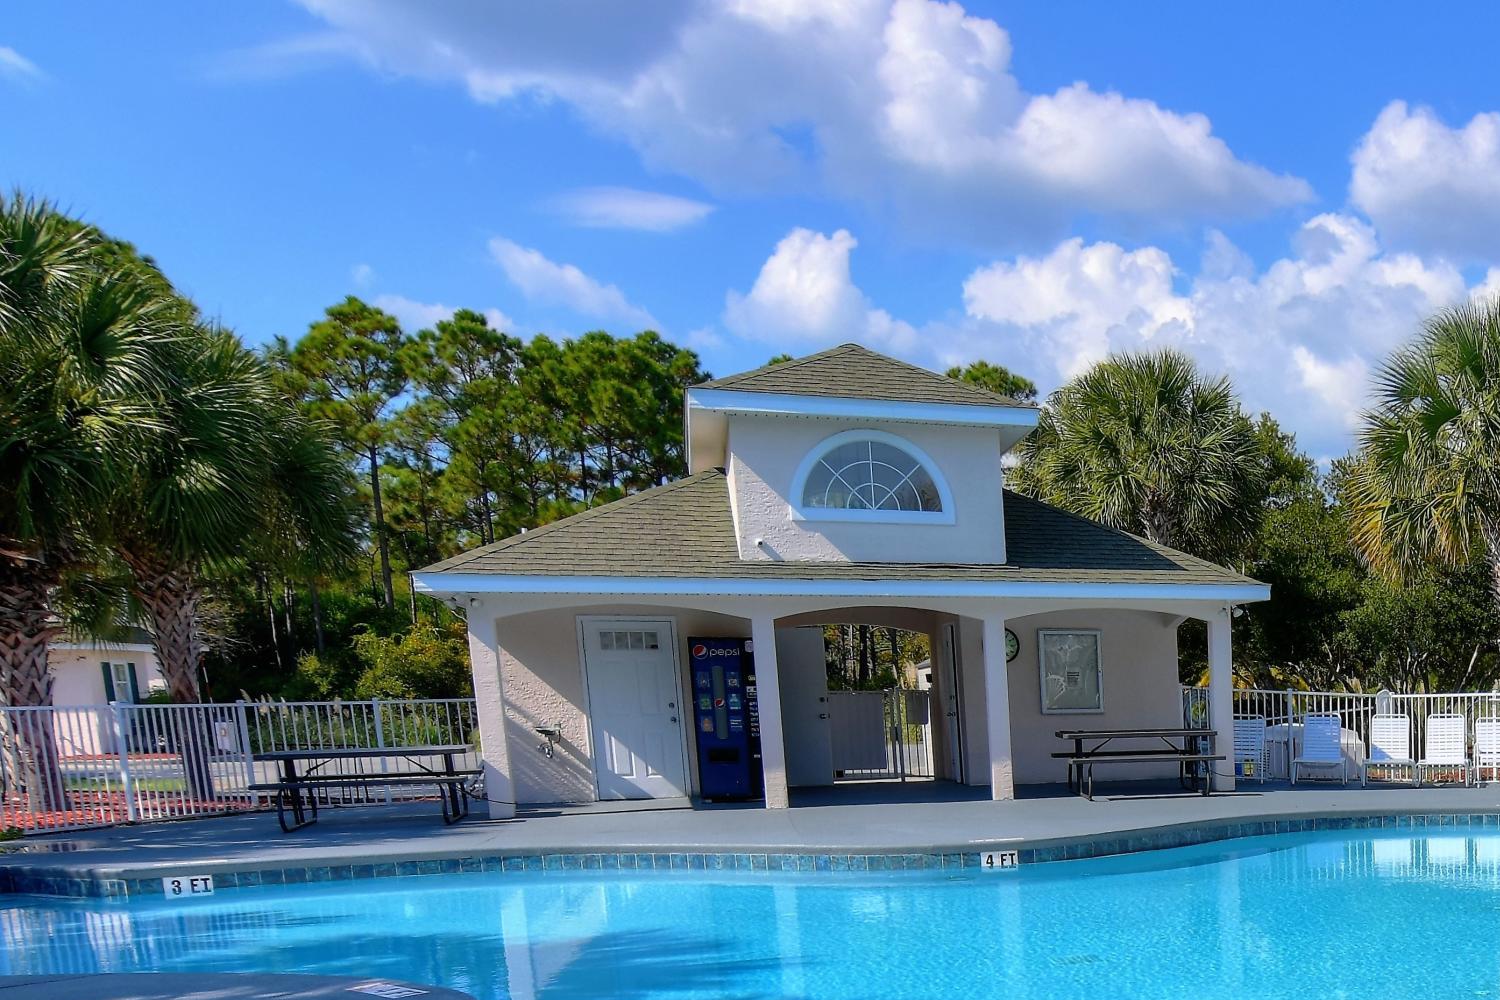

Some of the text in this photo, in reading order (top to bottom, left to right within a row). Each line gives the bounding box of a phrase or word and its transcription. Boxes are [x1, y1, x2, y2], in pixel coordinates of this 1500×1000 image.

[709, 648, 740, 657] pepsi
[986, 854, 994, 866] 4
[171, 879, 182, 895] 3
